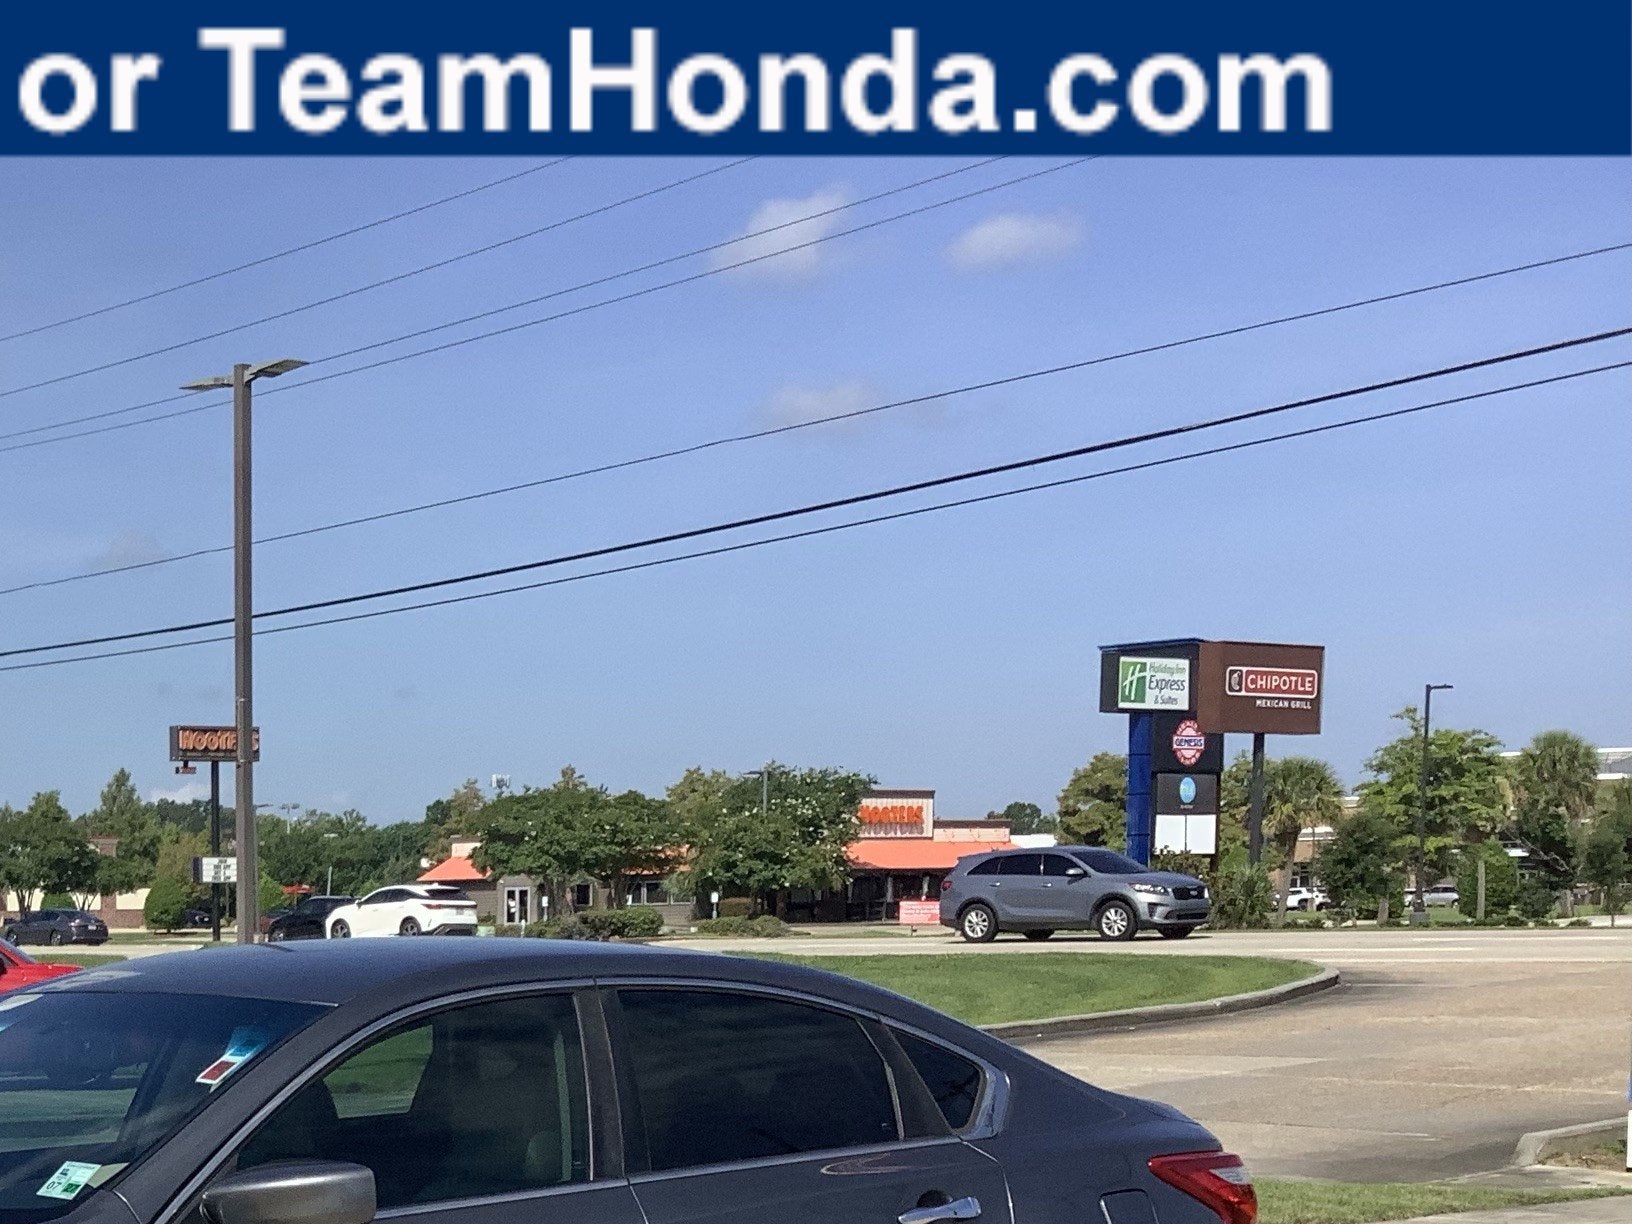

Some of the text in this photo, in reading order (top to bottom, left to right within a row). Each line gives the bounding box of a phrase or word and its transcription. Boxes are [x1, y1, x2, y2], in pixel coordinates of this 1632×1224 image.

[1148, 675, 1186, 692] Express
[1247, 674, 1314, 692] CHIPOTLE
[1255, 699, 1312, 709] MEXICAN GRILL
[179, 729, 260, 751] HOOTES
[1174, 738, 1203, 748] GENESIS
